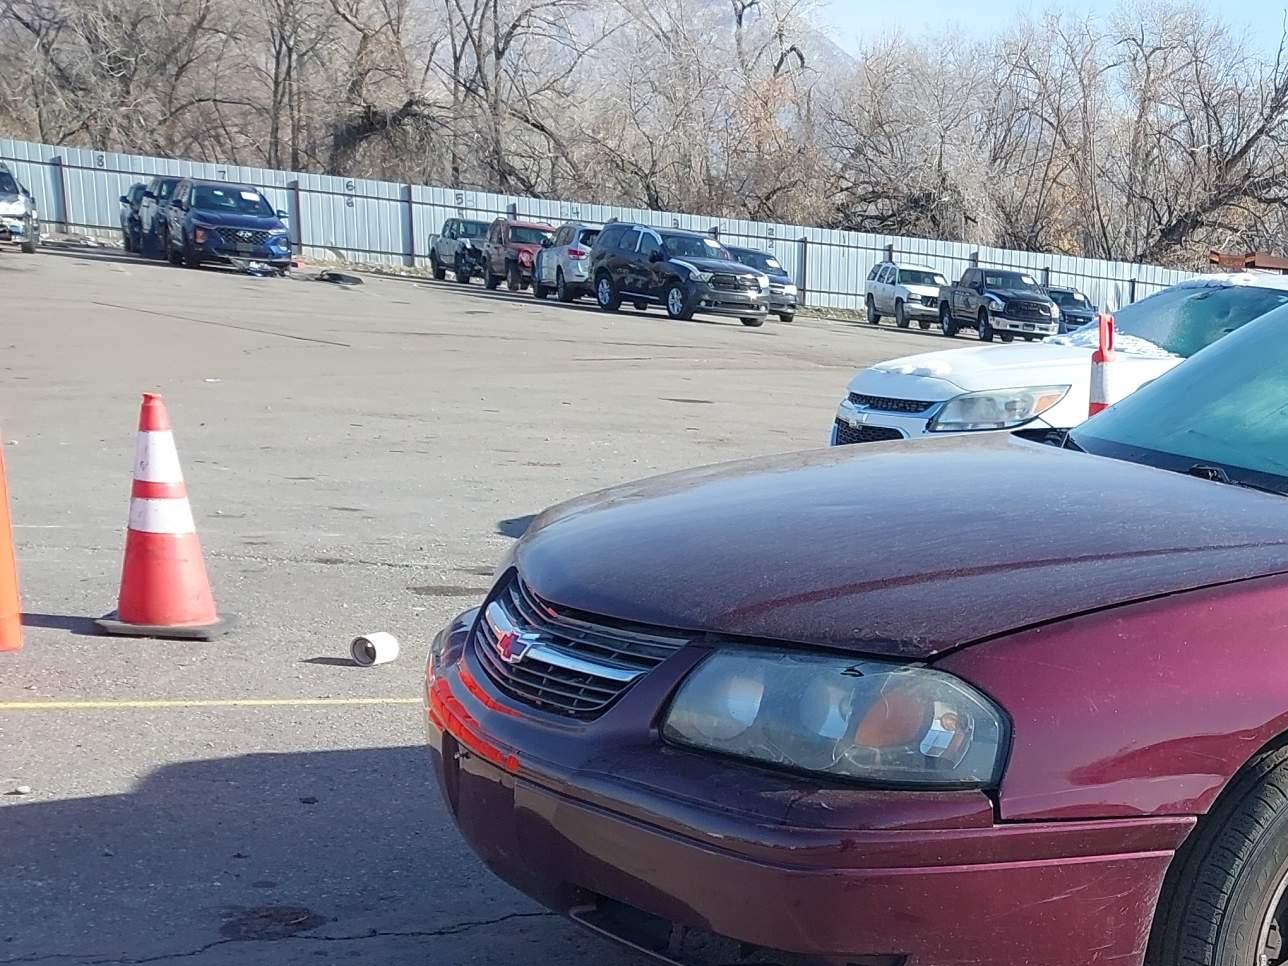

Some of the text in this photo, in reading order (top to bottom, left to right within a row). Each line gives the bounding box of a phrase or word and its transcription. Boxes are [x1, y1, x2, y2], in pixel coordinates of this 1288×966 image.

[96, 154, 105, 167] 8
[345, 180, 355, 191] 6
[455, 193, 464, 205] 5
